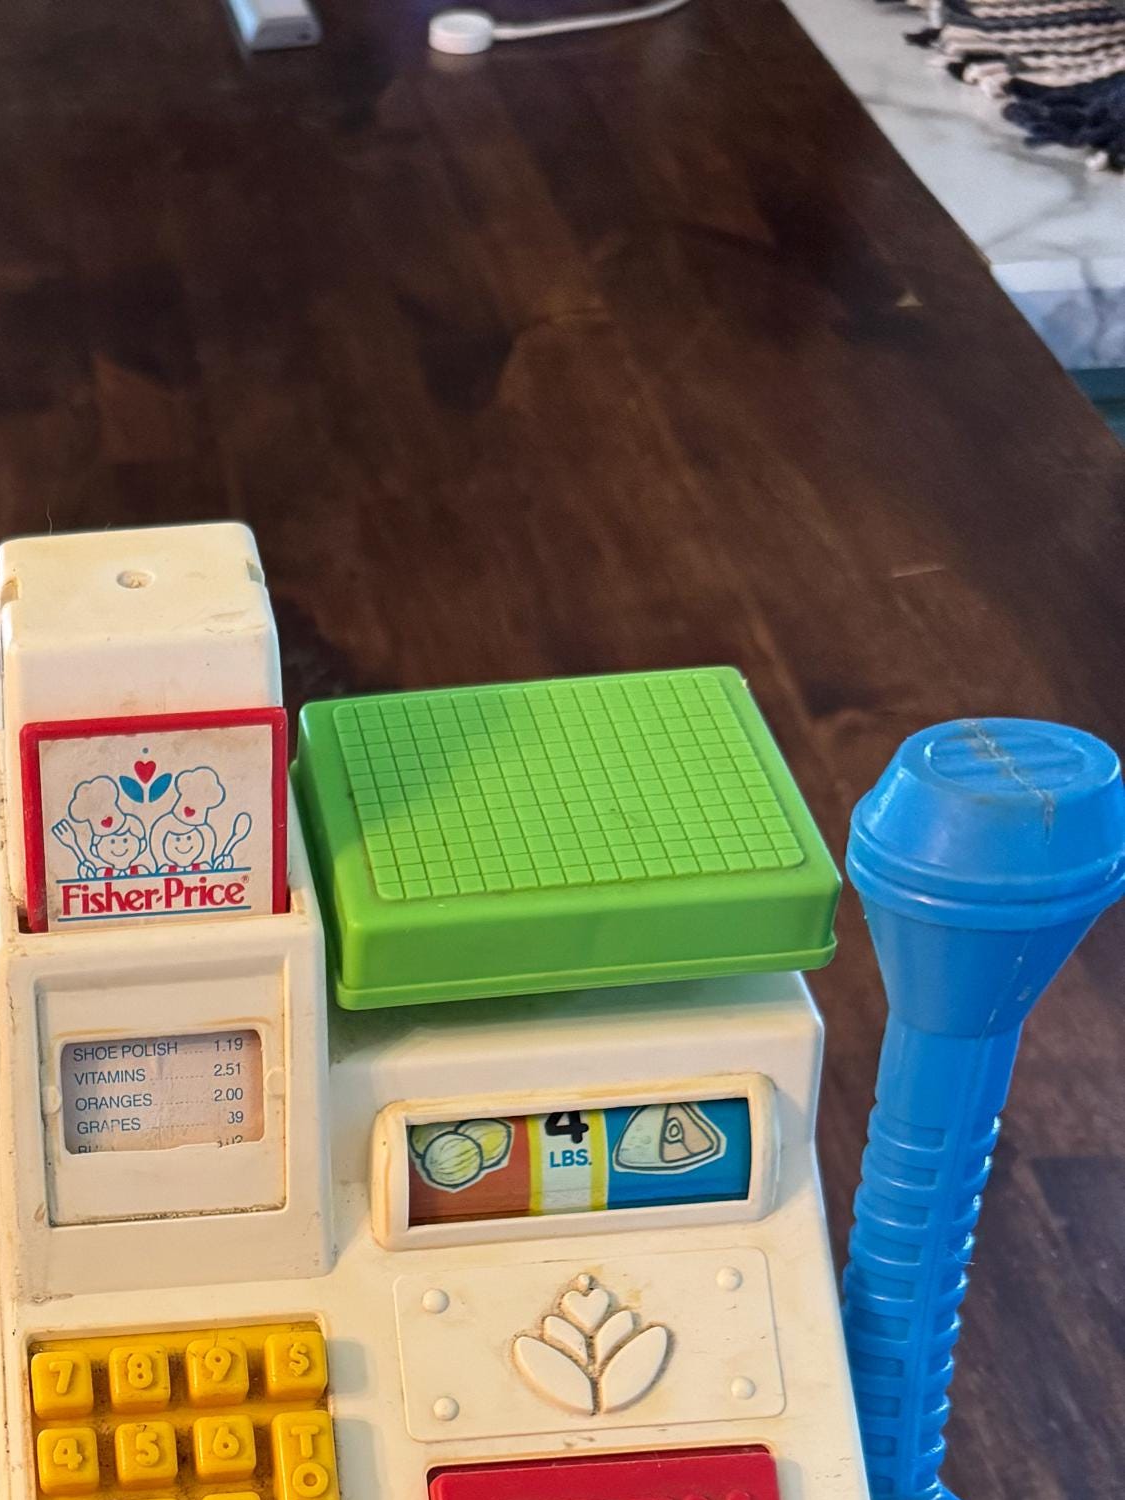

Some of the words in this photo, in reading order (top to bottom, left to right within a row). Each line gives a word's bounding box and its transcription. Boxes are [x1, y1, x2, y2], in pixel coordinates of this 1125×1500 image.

[73, 1045, 118, 1061] SHOE
[122, 1042, 178, 1058] POLISH
[214, 1038, 243, 1051] 1.19
[75, 1068, 146, 1085] VITAMINS
[213, 1062, 241, 1076] 2.51
[76, 1093, 153, 1111] ORANGES
[77, 1117, 141, 1134] GRAPES
[543, 1111, 589, 1144] 4
[549, 1149, 593, 1169] LBS.
[49, 1360, 73, 1394] 7
[127, 1353, 154, 1389] 8
[205, 1346, 232, 1382] 9
[53, 1438, 83, 1470] 4
[136, 1431, 160, 1466] 5
[213, 1425, 239, 1459] 6
